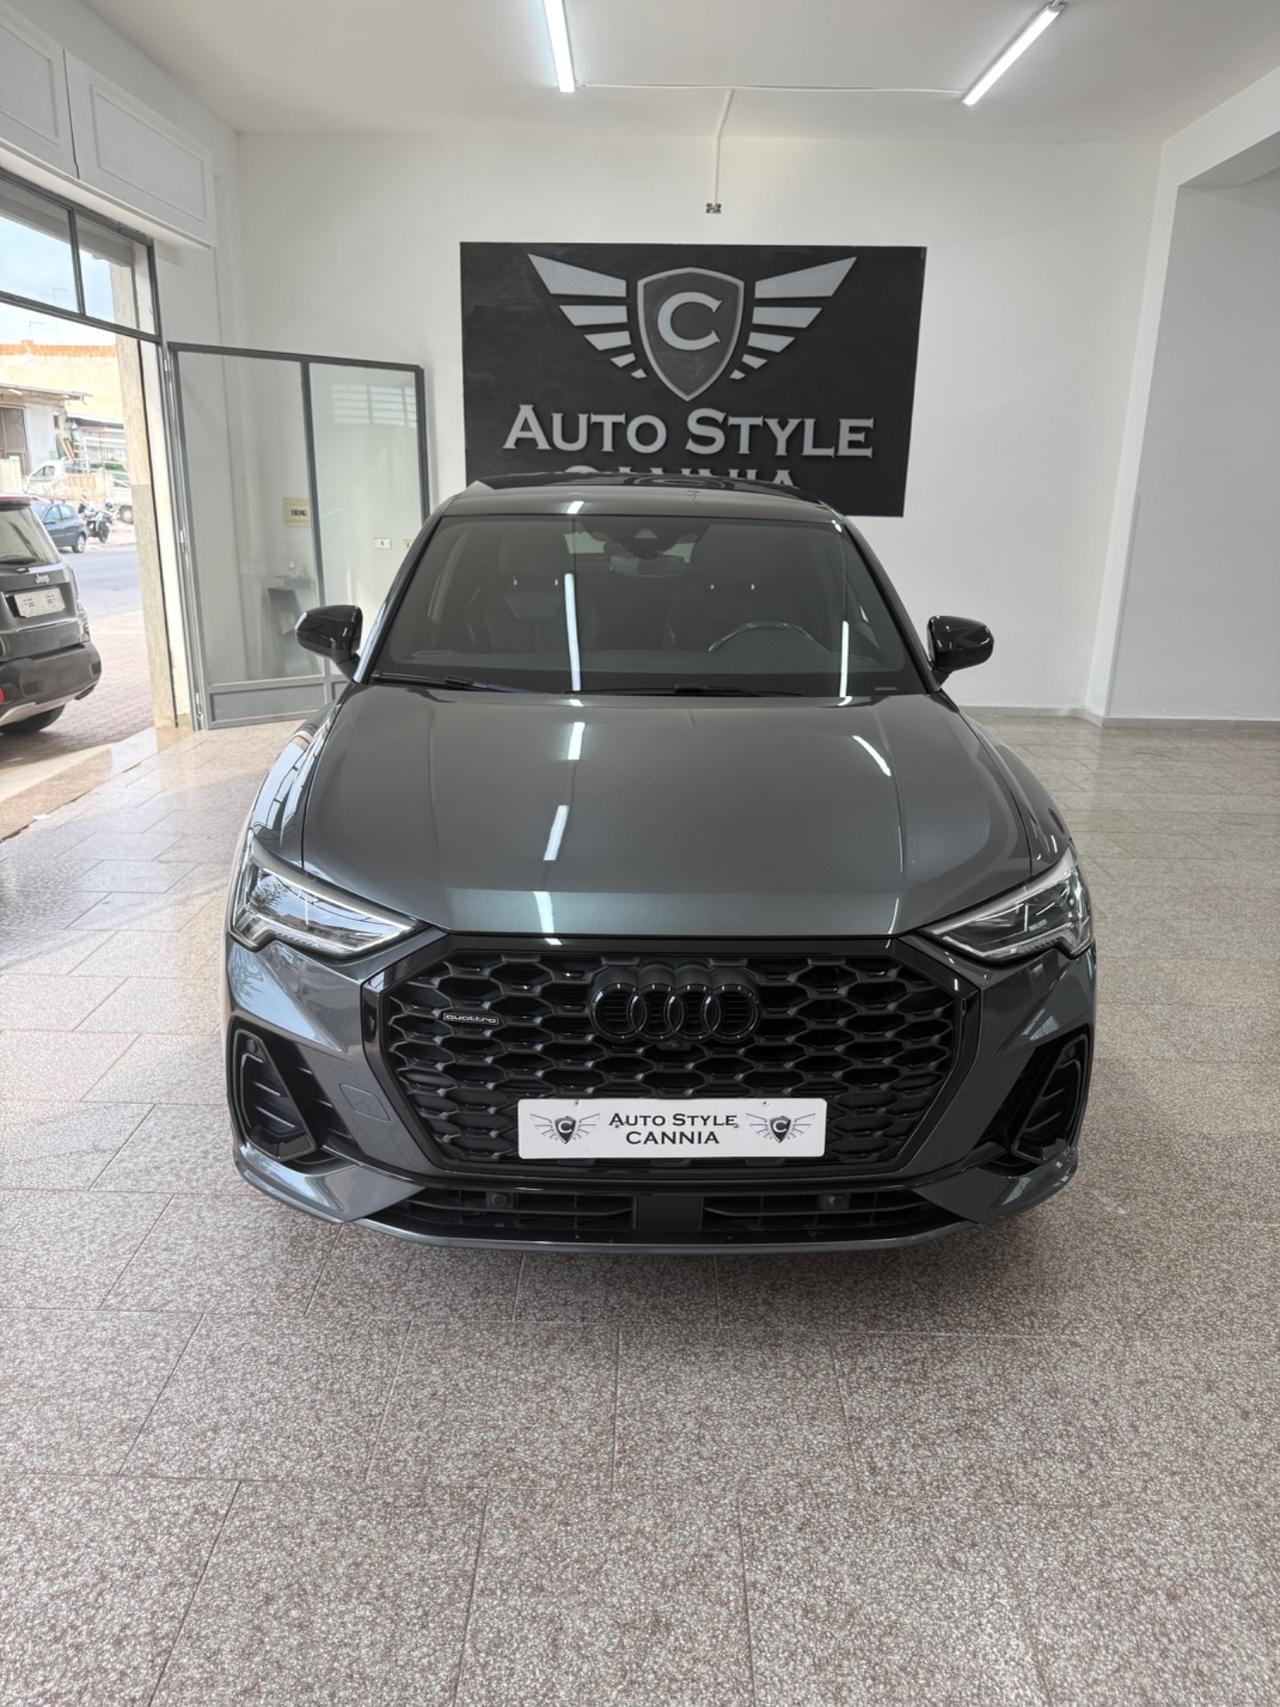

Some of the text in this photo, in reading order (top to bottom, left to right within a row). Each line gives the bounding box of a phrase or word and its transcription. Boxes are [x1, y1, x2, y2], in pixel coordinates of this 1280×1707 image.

[657, 291, 723, 351] C
[502, 404, 875, 458] AUTO STYLE
[445, 1014, 497, 1024] quattro
[558, 1120, 573, 1134] C
[608, 1113, 738, 1127] AUTO STYLE
[772, 1120, 788, 1133] C
[625, 1131, 720, 1145] CANNIA
